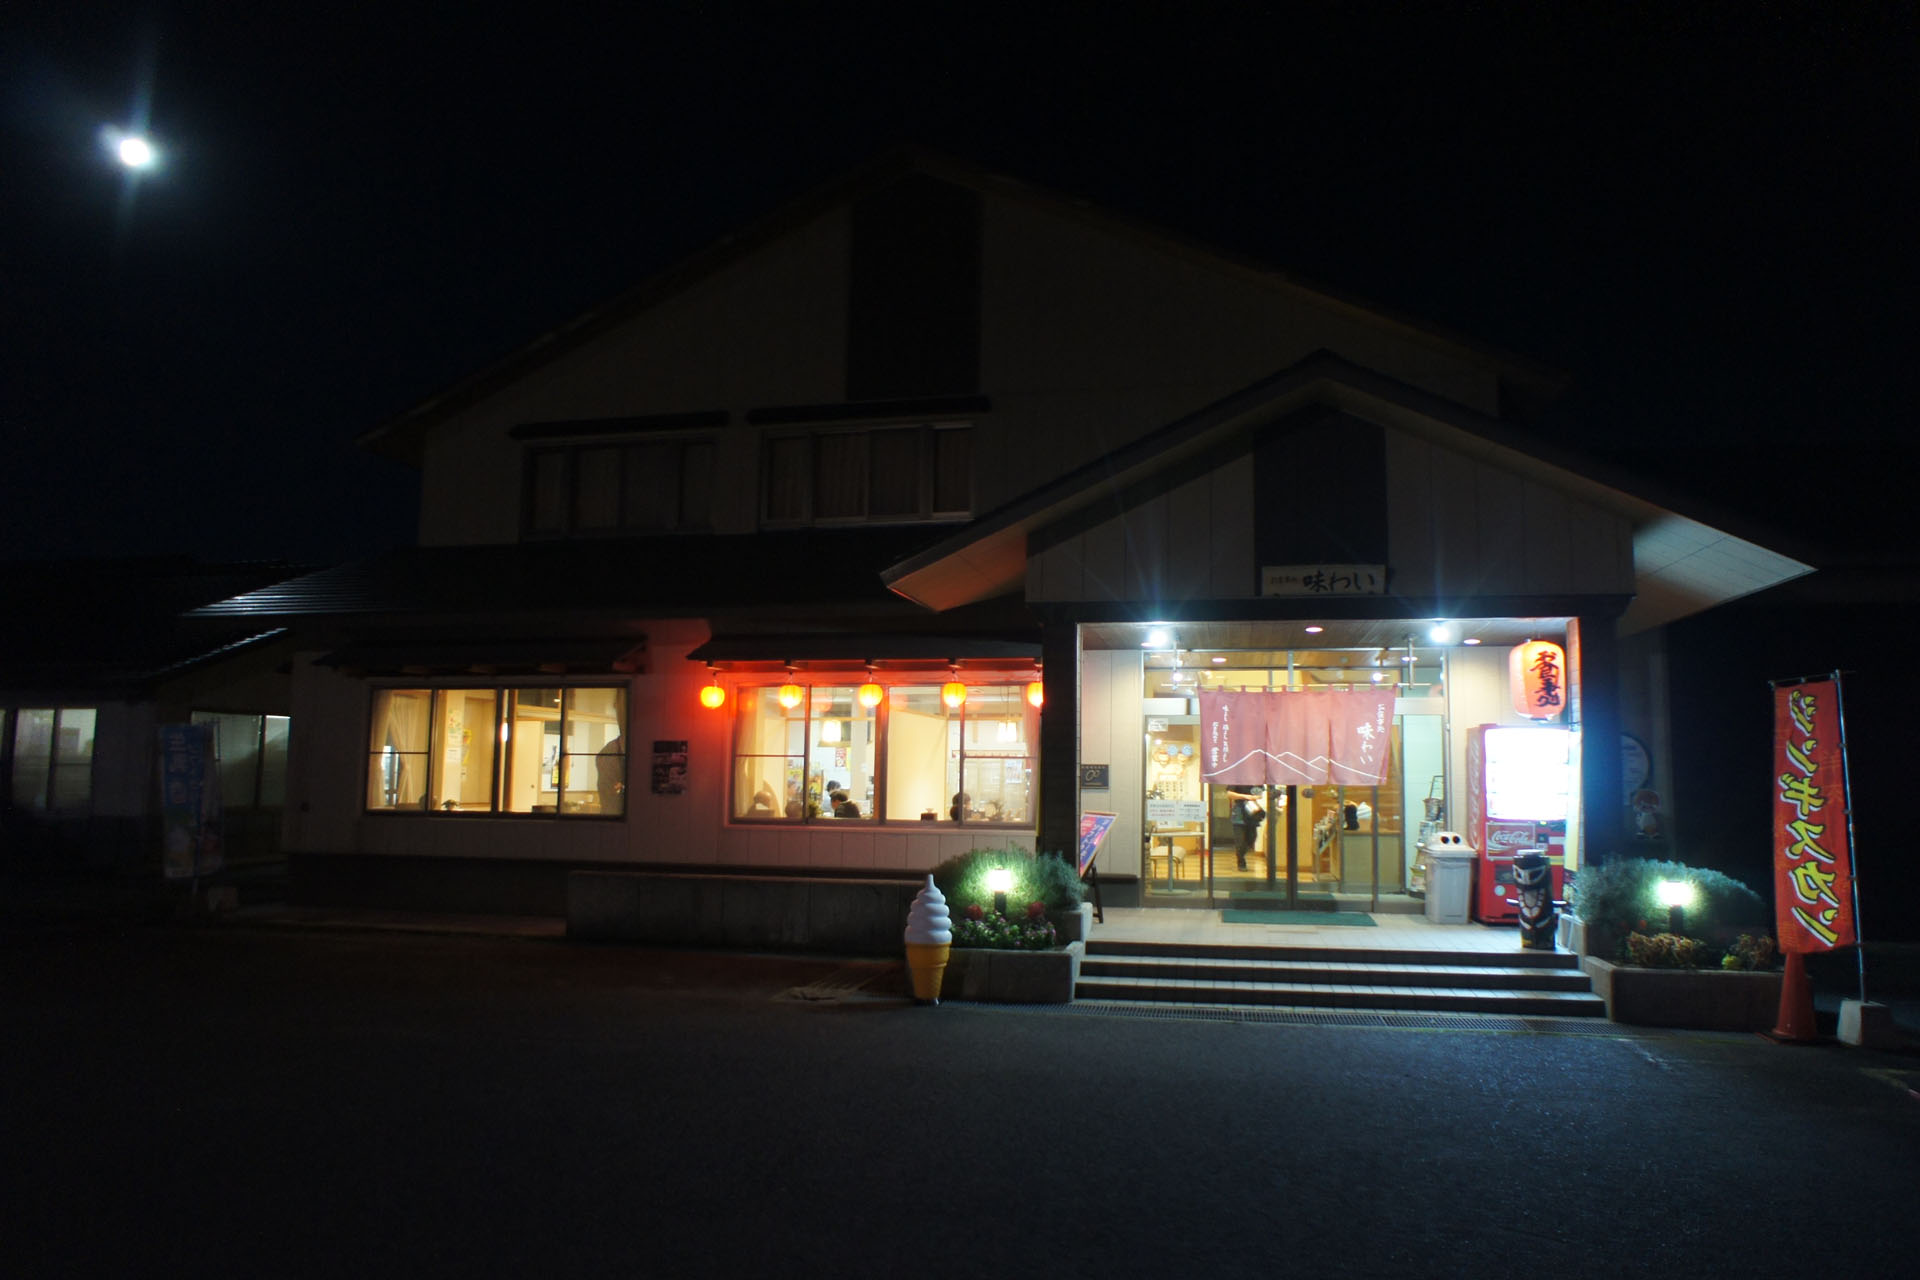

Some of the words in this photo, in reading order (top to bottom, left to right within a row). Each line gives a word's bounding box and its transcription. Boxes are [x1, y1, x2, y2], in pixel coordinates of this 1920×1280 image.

[1303, 570, 1375, 593] 味わい
[1356, 722, 1376, 765] 味わい
